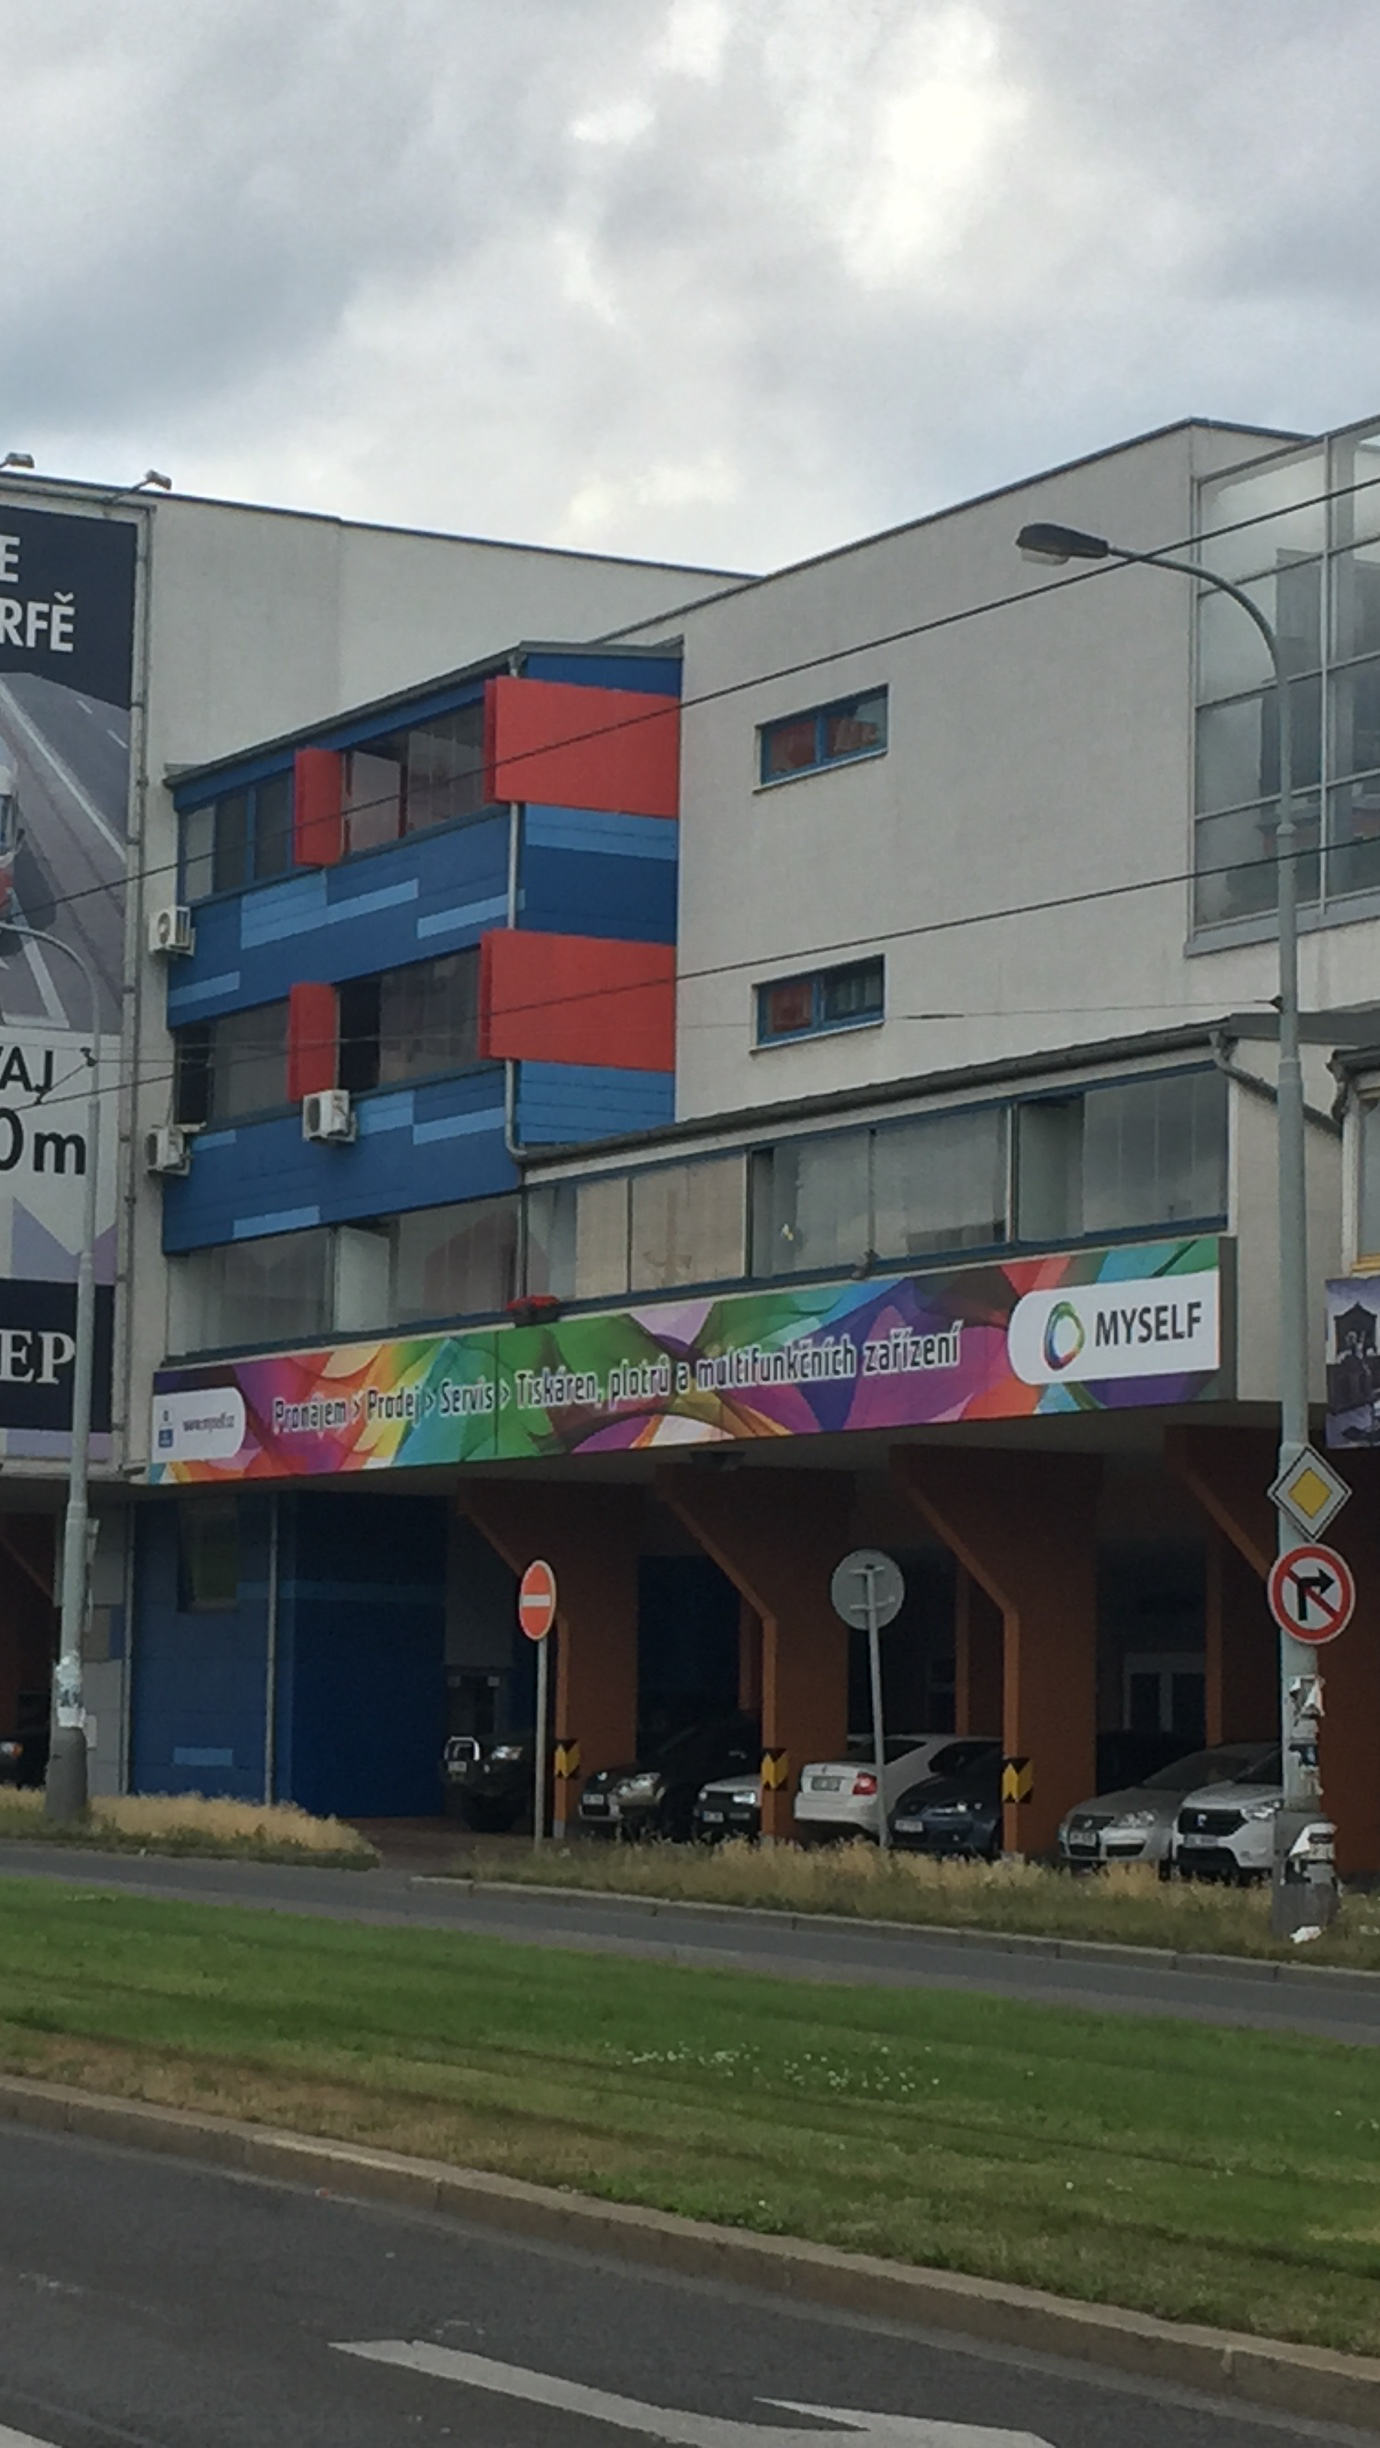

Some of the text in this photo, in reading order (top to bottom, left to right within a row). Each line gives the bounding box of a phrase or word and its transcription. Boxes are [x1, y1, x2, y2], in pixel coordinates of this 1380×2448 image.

[0, 534, 20, 582] E
[0, 591, 75, 652] RFĚ
[0, 1046, 53, 1092] AJ
[1095, 1301, 1202, 1347] MYSELF
[0, 1329, 76, 1384] EP
[367, 1386, 420, 1425] Prodej
[440, 1378, 493, 1413] Servis
[676, 1362, 689, 1393] a
[698, 1337, 856, 1388] multifunkčních
[865, 1322, 963, 1374] zařízení
